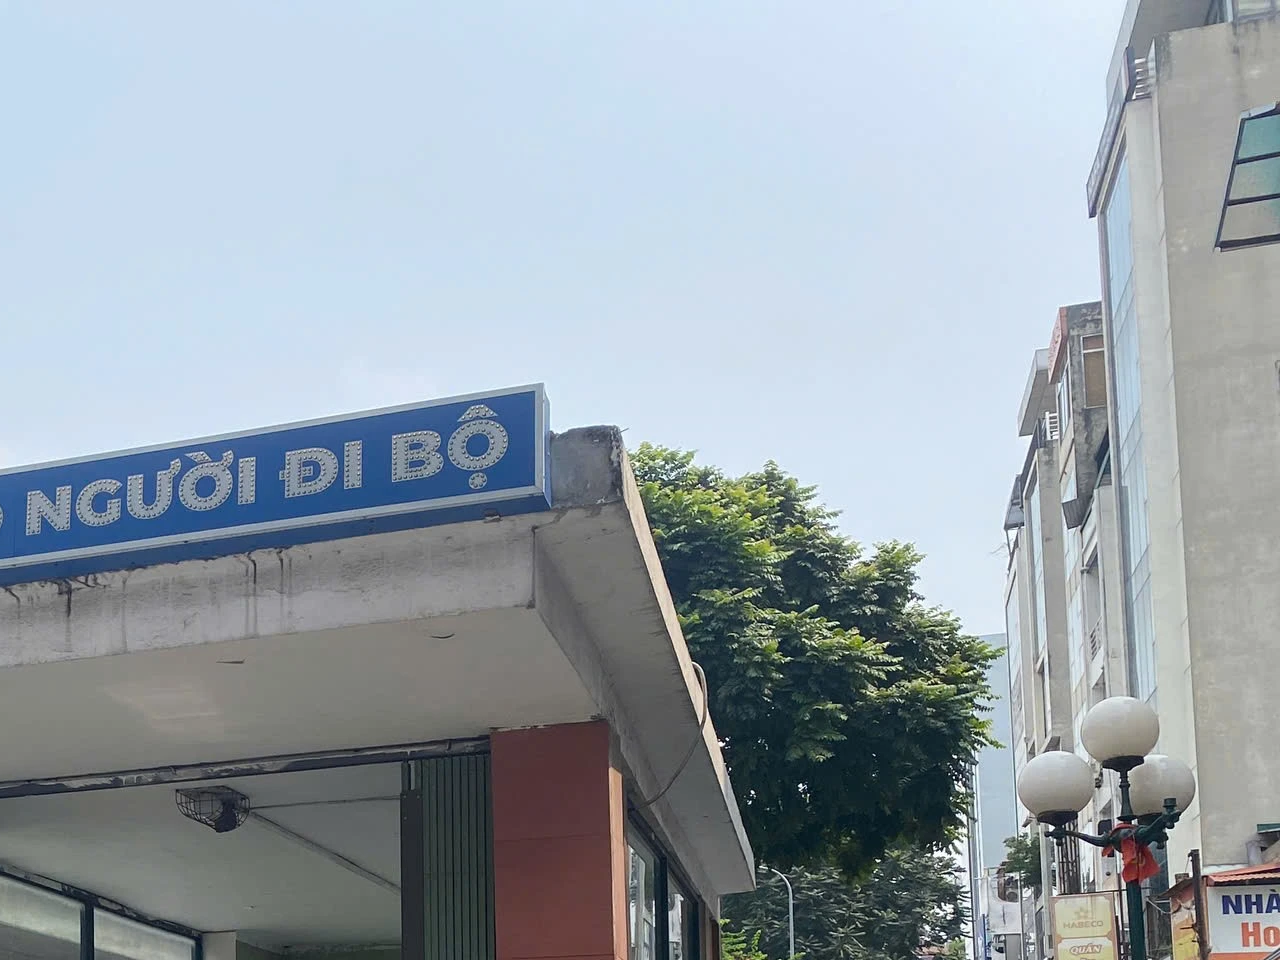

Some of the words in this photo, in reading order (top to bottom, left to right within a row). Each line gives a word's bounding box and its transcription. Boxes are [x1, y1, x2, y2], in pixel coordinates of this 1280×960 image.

[26, 449, 256, 536] NGƯỜI
[279, 440, 363, 498] ĐI
[392, 404, 509, 489] BỘ
[1222, 889, 1280, 915] NHÀ
[1063, 920, 1104, 929] HABECO
